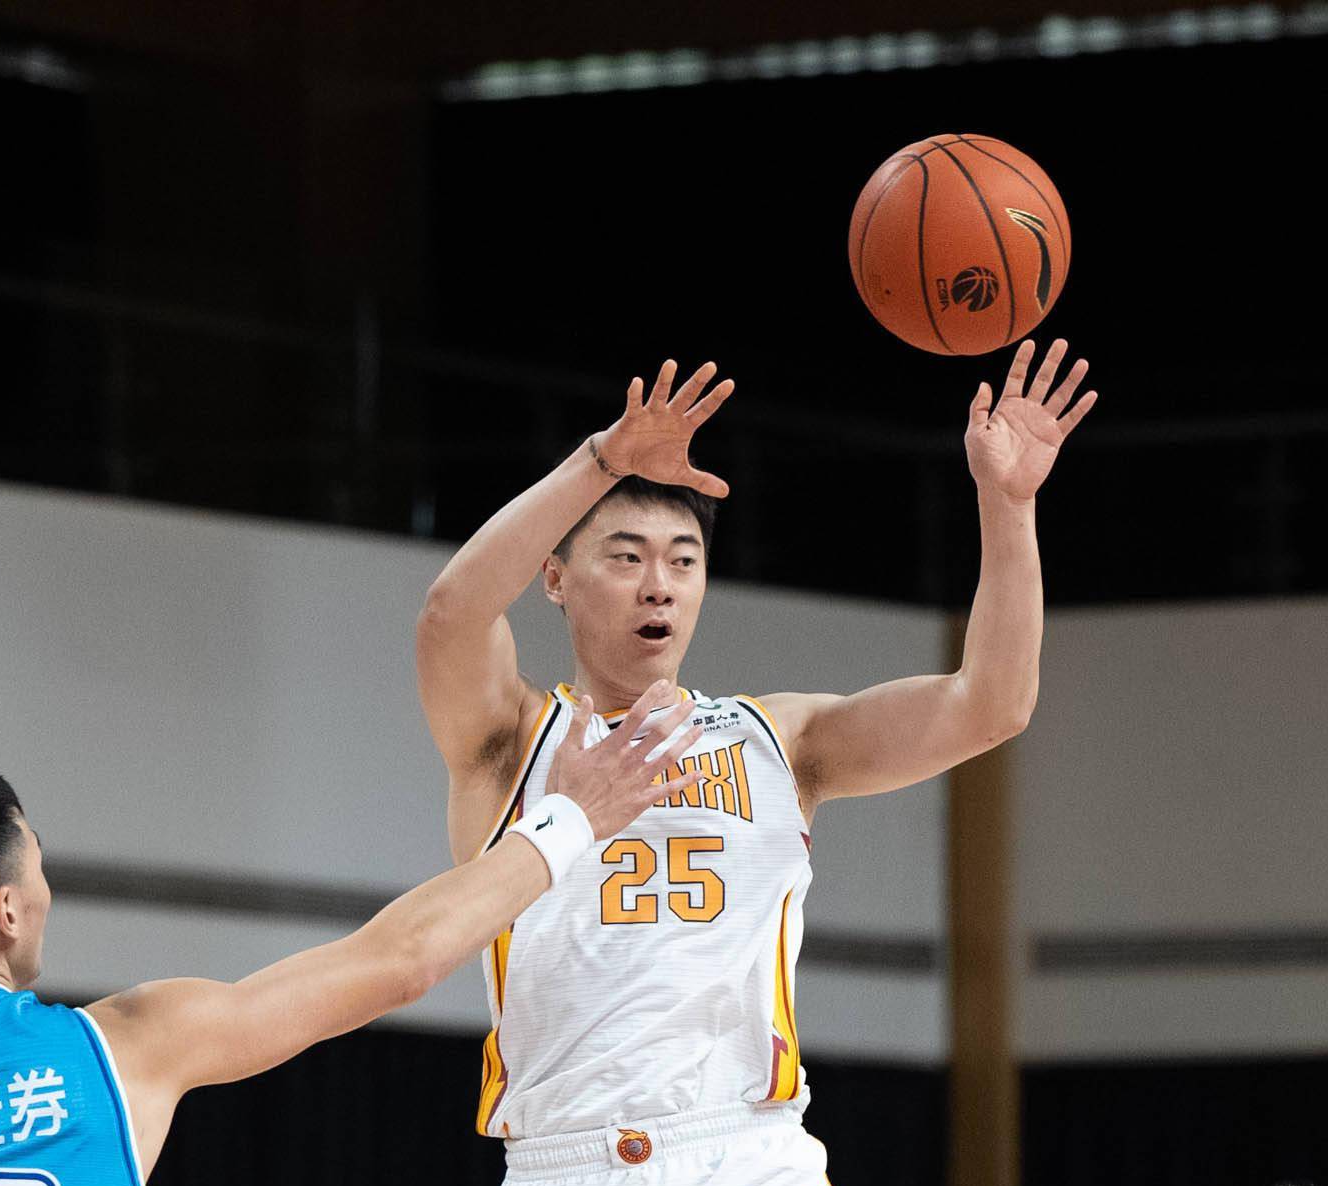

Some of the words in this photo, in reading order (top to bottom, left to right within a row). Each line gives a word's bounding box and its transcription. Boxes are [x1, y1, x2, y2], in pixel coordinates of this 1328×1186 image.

[693, 712, 740, 726] 中国人寿
[599, 835, 726, 926] 25
